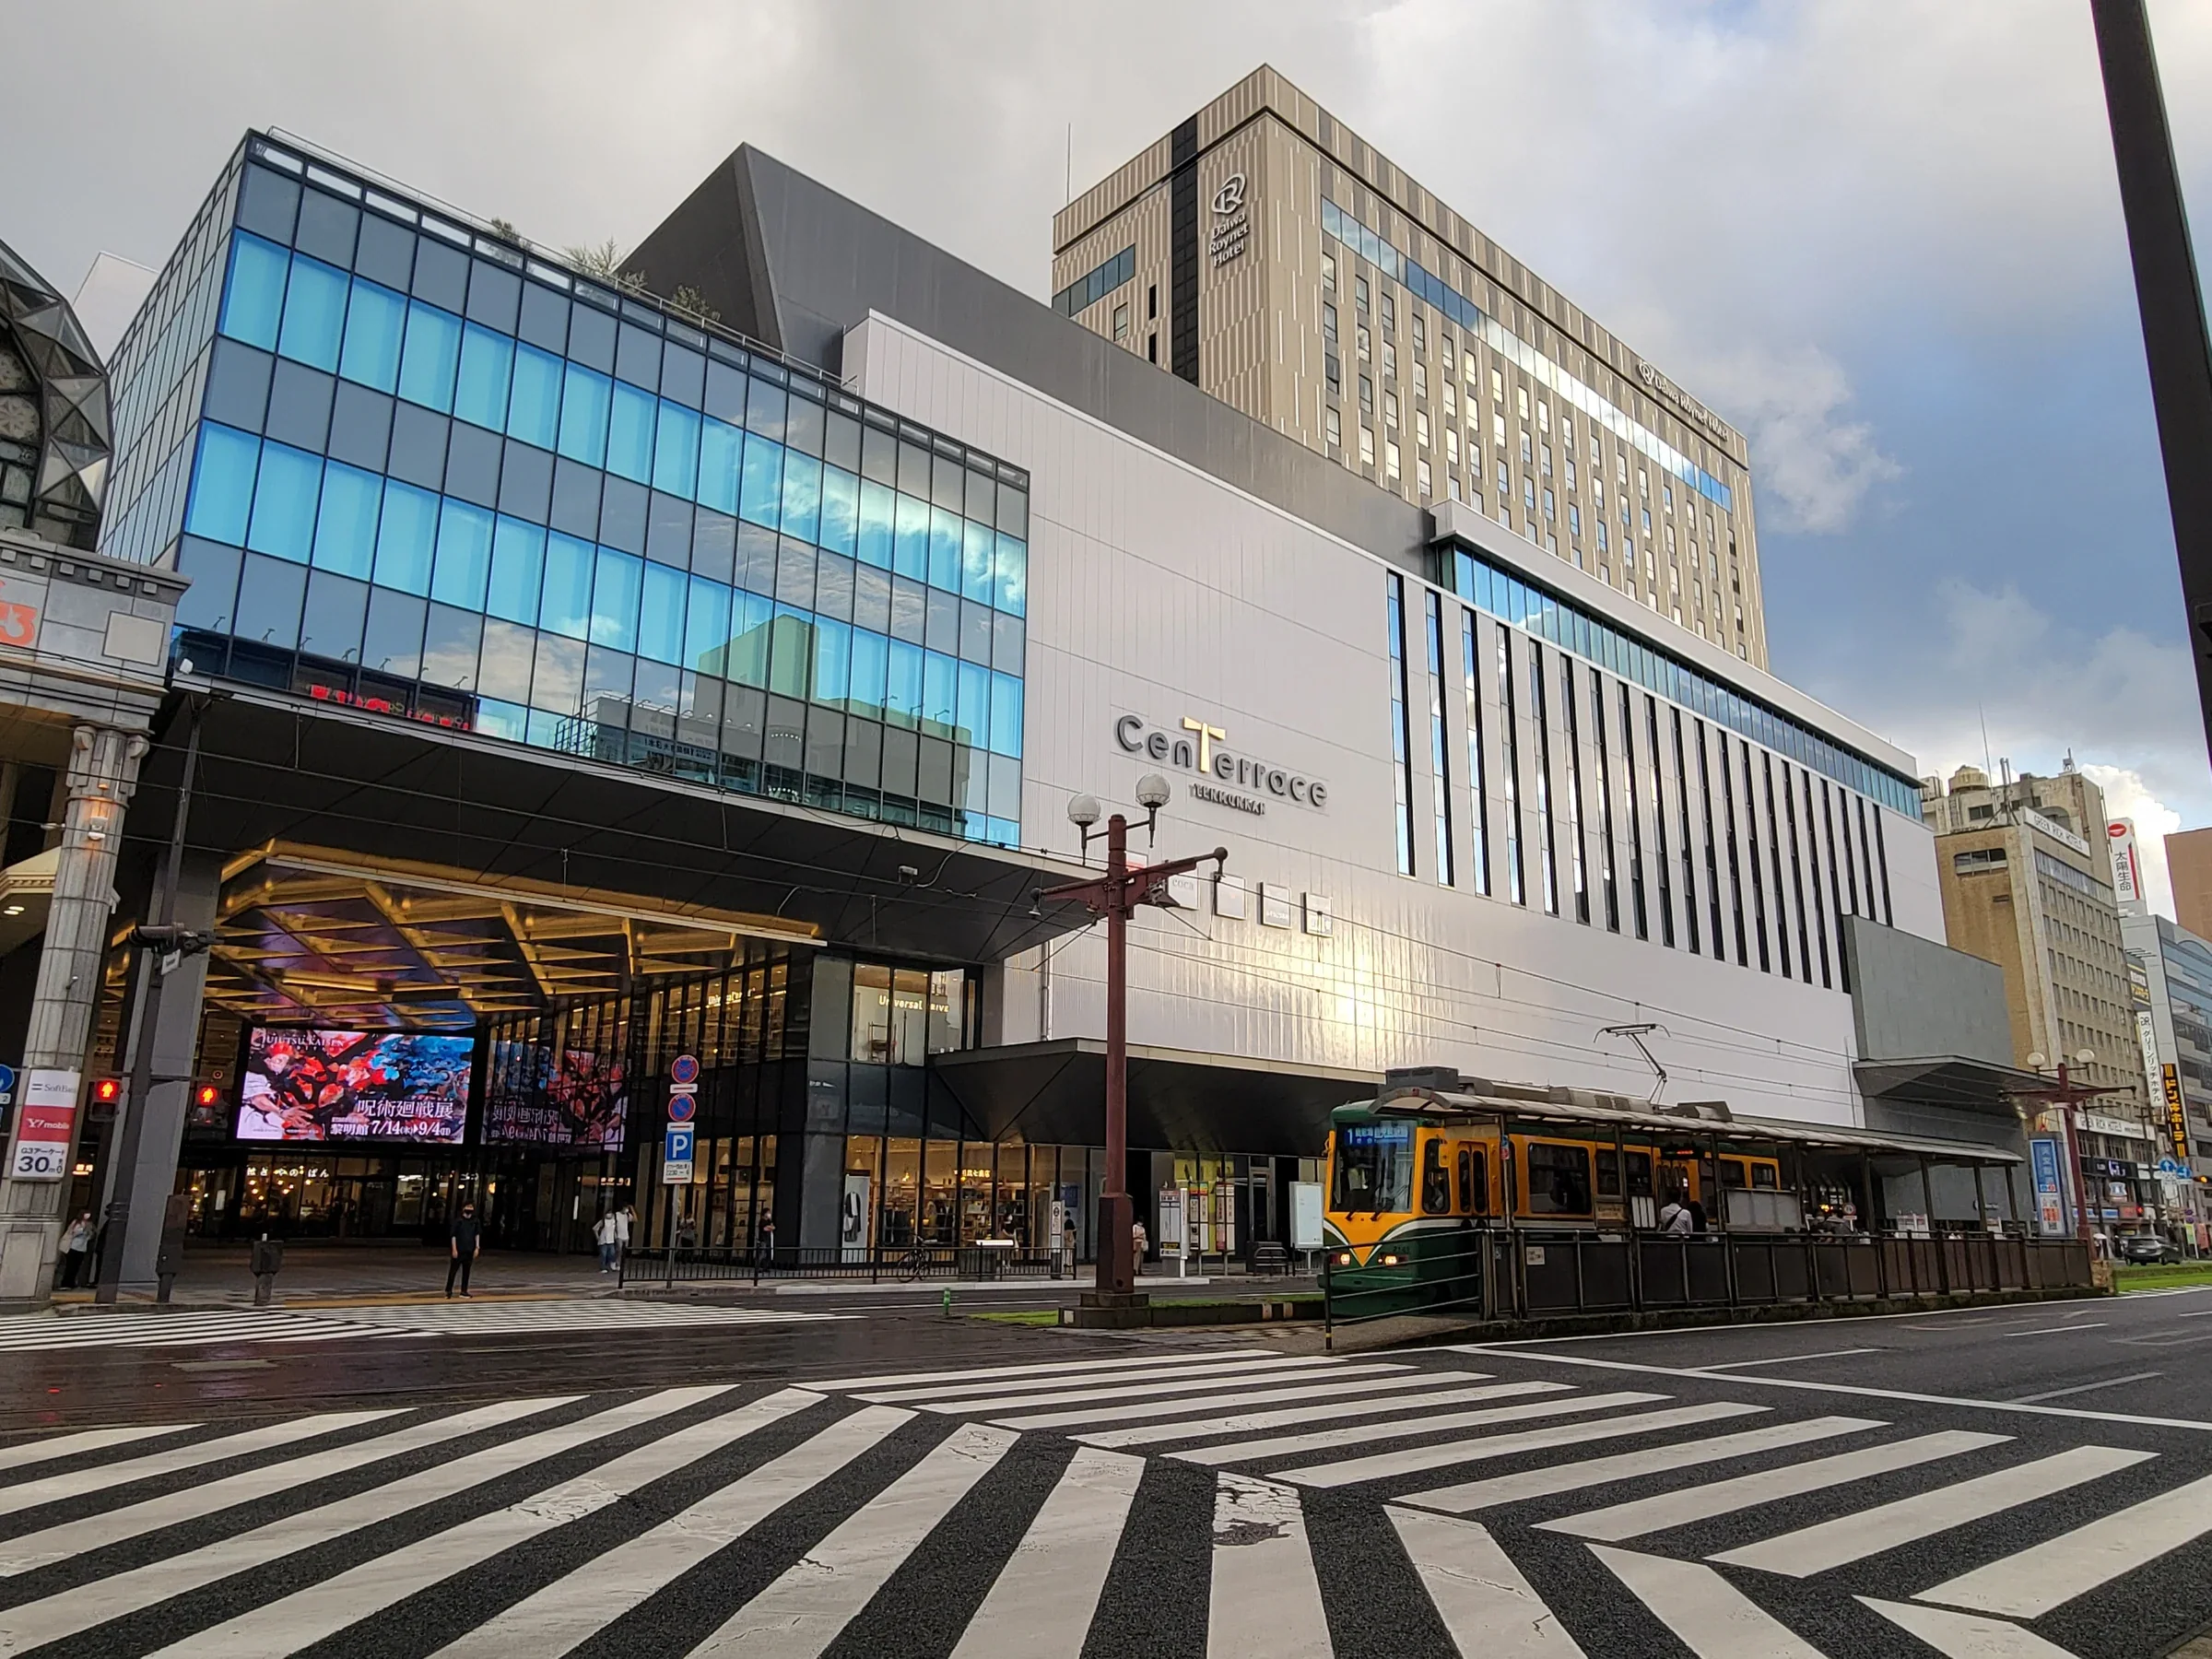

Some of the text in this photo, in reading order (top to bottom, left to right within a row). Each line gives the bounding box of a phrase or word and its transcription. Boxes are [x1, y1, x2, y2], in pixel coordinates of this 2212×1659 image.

[1208, 222, 1250, 256] Roynet
[1212, 212, 1246, 241] Daiwa
[1213, 239, 1245, 268] Hotel
[1116, 715, 1327, 806] CenTerrace
[2114, 851, 2132, 892] 太陽生命
[878, 994, 924, 1011] Unversal
[357, 1100, 454, 1119] 呪術廻戦展
[672, 1135, 688, 1159] P
